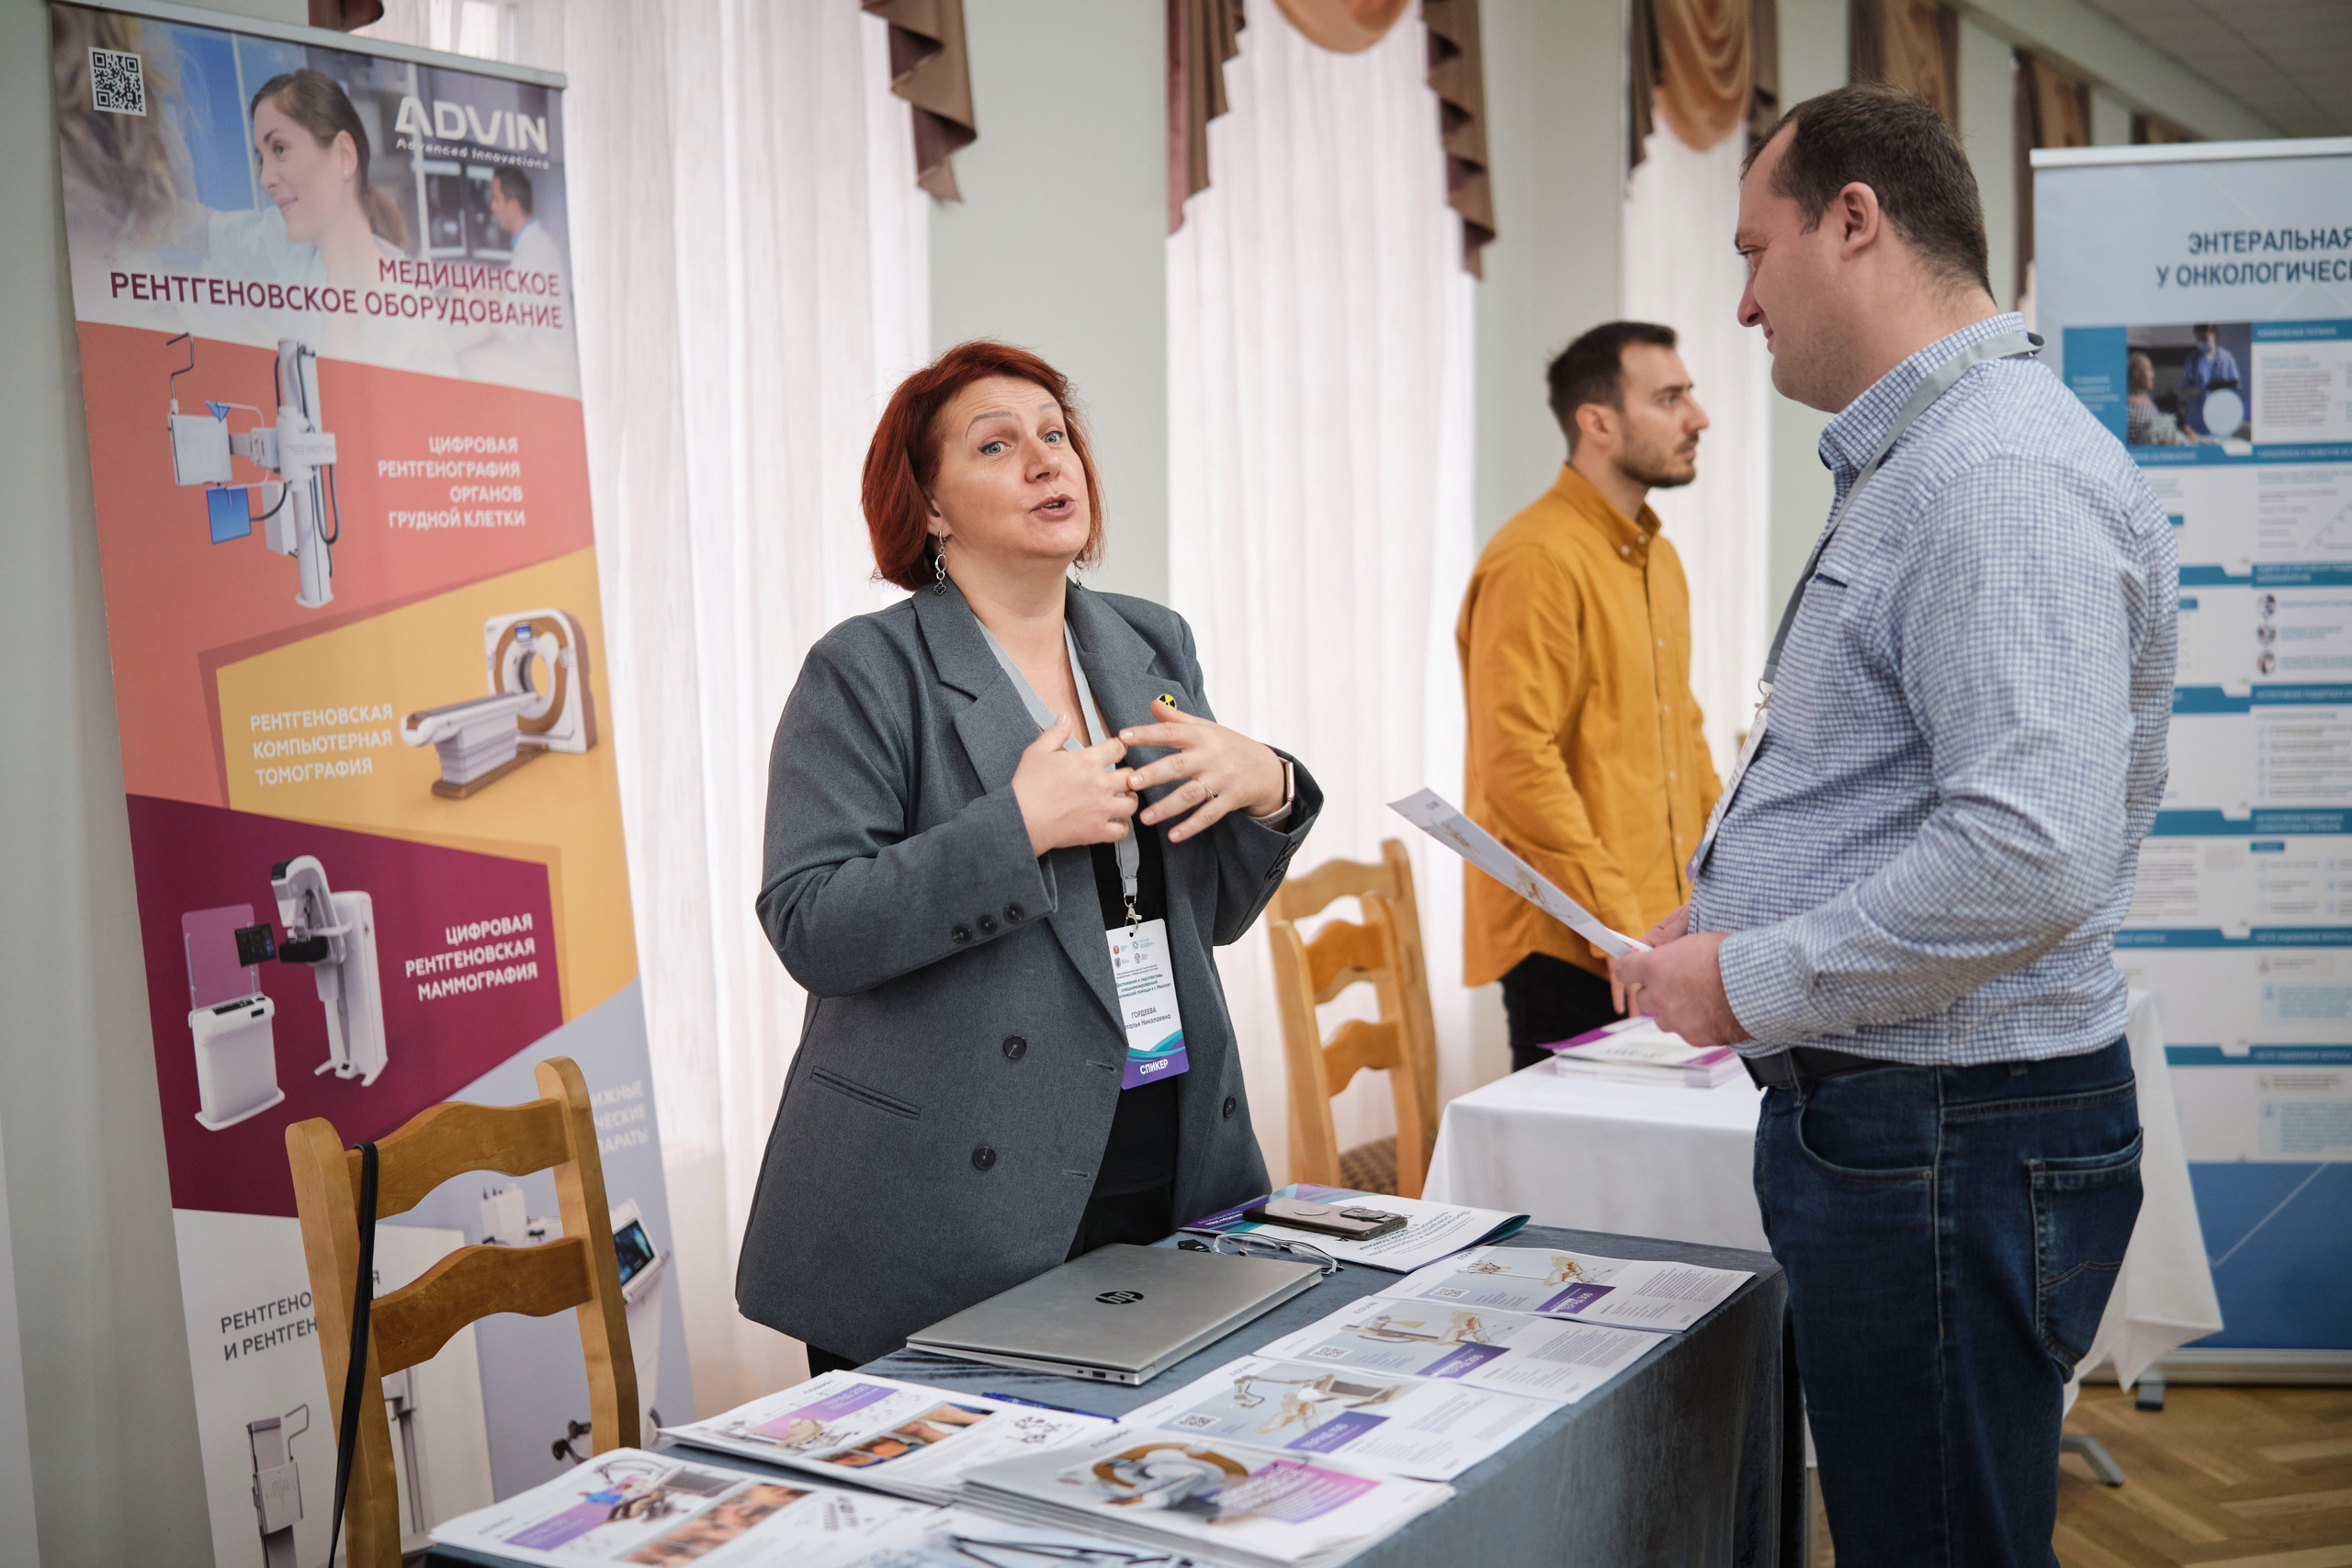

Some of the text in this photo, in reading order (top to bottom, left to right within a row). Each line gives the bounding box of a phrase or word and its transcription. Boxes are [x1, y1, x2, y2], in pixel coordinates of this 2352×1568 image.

[394, 96, 548, 154] ADVIN
[396, 138, 549, 170] Advanced Innovations
[2188, 227, 2352, 254] ЭНТЕРАЛЬНАЯ
[379, 258, 560, 297] МЕДИЦИНСКОЕ
[2156, 265, 2169, 288] У
[109, 271, 563, 330] РЕНТГЕНОВСКОЕ ОБОРУДОВАНИЕ
[428, 435, 519, 456] ЦИФРОВАЯ
[378, 460, 521, 479] РЕНТГЕНОГРАФИЯ
[449, 485, 524, 503] ОРГАНОВ
[388, 507, 526, 531] ГРУДНОЙ КЛЕТКИ
[250, 703, 393, 733] РЕНТГЕНОВСКАЯ
[253, 728, 393, 760] КОМПЬЮТЕРНАЯ
[254, 757, 373, 786] ТОМОГРАФИЯ
[445, 912, 534, 946] ЦИФРОВАЯ
[404, 937, 536, 978] РЕНТГЕНОВСКАЯ
[417, 961, 538, 1002] МАММОГРАФИЯ
[1125, 1013, 1171, 1030] талья Николаевна
[1131, 1007, 1157, 1019] ГОРДЕЕВА
[1139, 1058, 1169, 1075] СПИКЕР
[1095, 1290, 1143, 1304] hp
[224, 1316, 319, 1361] И РЕНТГЕН
